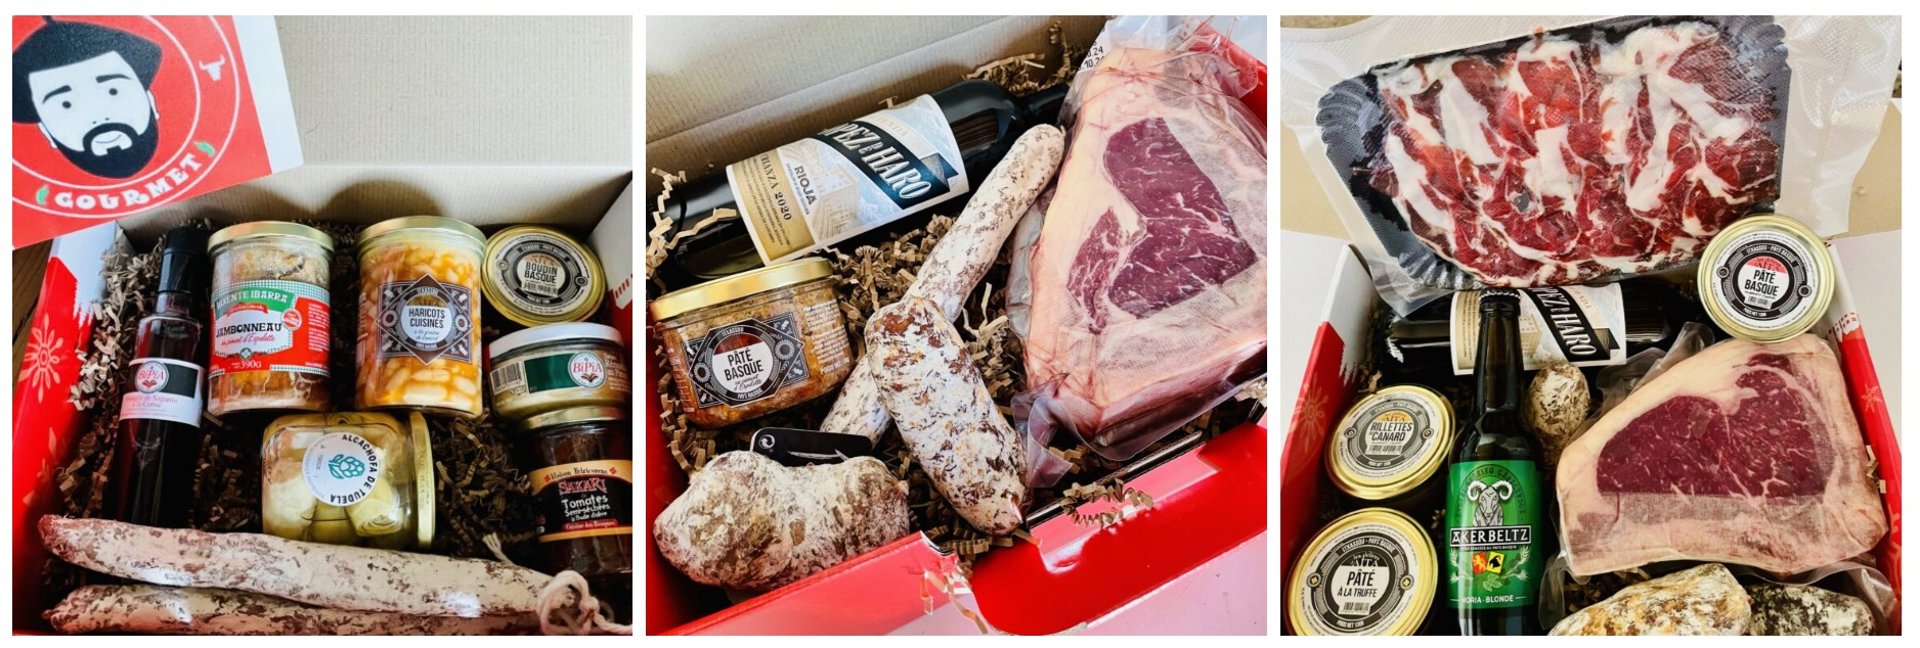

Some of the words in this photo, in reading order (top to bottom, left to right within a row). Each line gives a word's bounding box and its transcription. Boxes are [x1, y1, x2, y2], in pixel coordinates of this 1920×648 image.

[861, 146, 932, 199] HARO
[55, 153, 202, 209] GOURMET
[795, 166, 817, 205] RIOJA
[775, 191, 792, 221] 2020
[524, 269, 558, 284] BASQUE
[525, 262, 558, 276] BOUDIN
[1753, 270, 1776, 285] PÂTÉ
[250, 290, 288, 303] IBARRA
[1744, 280, 1779, 297] BASQUE
[409, 308, 446, 319] HARICOTS
[216, 322, 282, 338] JAMBONNEAU
[1550, 313, 1598, 356] HARO
[727, 347, 753, 367] PÂTÉ
[724, 359, 764, 381] BASQUE
[1370, 422, 1413, 432] RILLETTES
[1371, 431, 1406, 442] CANARD
[342, 434, 378, 472] ALCACHOFA
[364, 475, 376, 490] DE
[330, 489, 366, 504] TUDELA
[561, 494, 608, 510] Tomates
[1346, 568, 1376, 587] PÂTÉ
[1344, 588, 1352, 597] LA
[1353, 588, 1378, 598] TRUFFE
[1485, 594, 1515, 603] BLONDE
